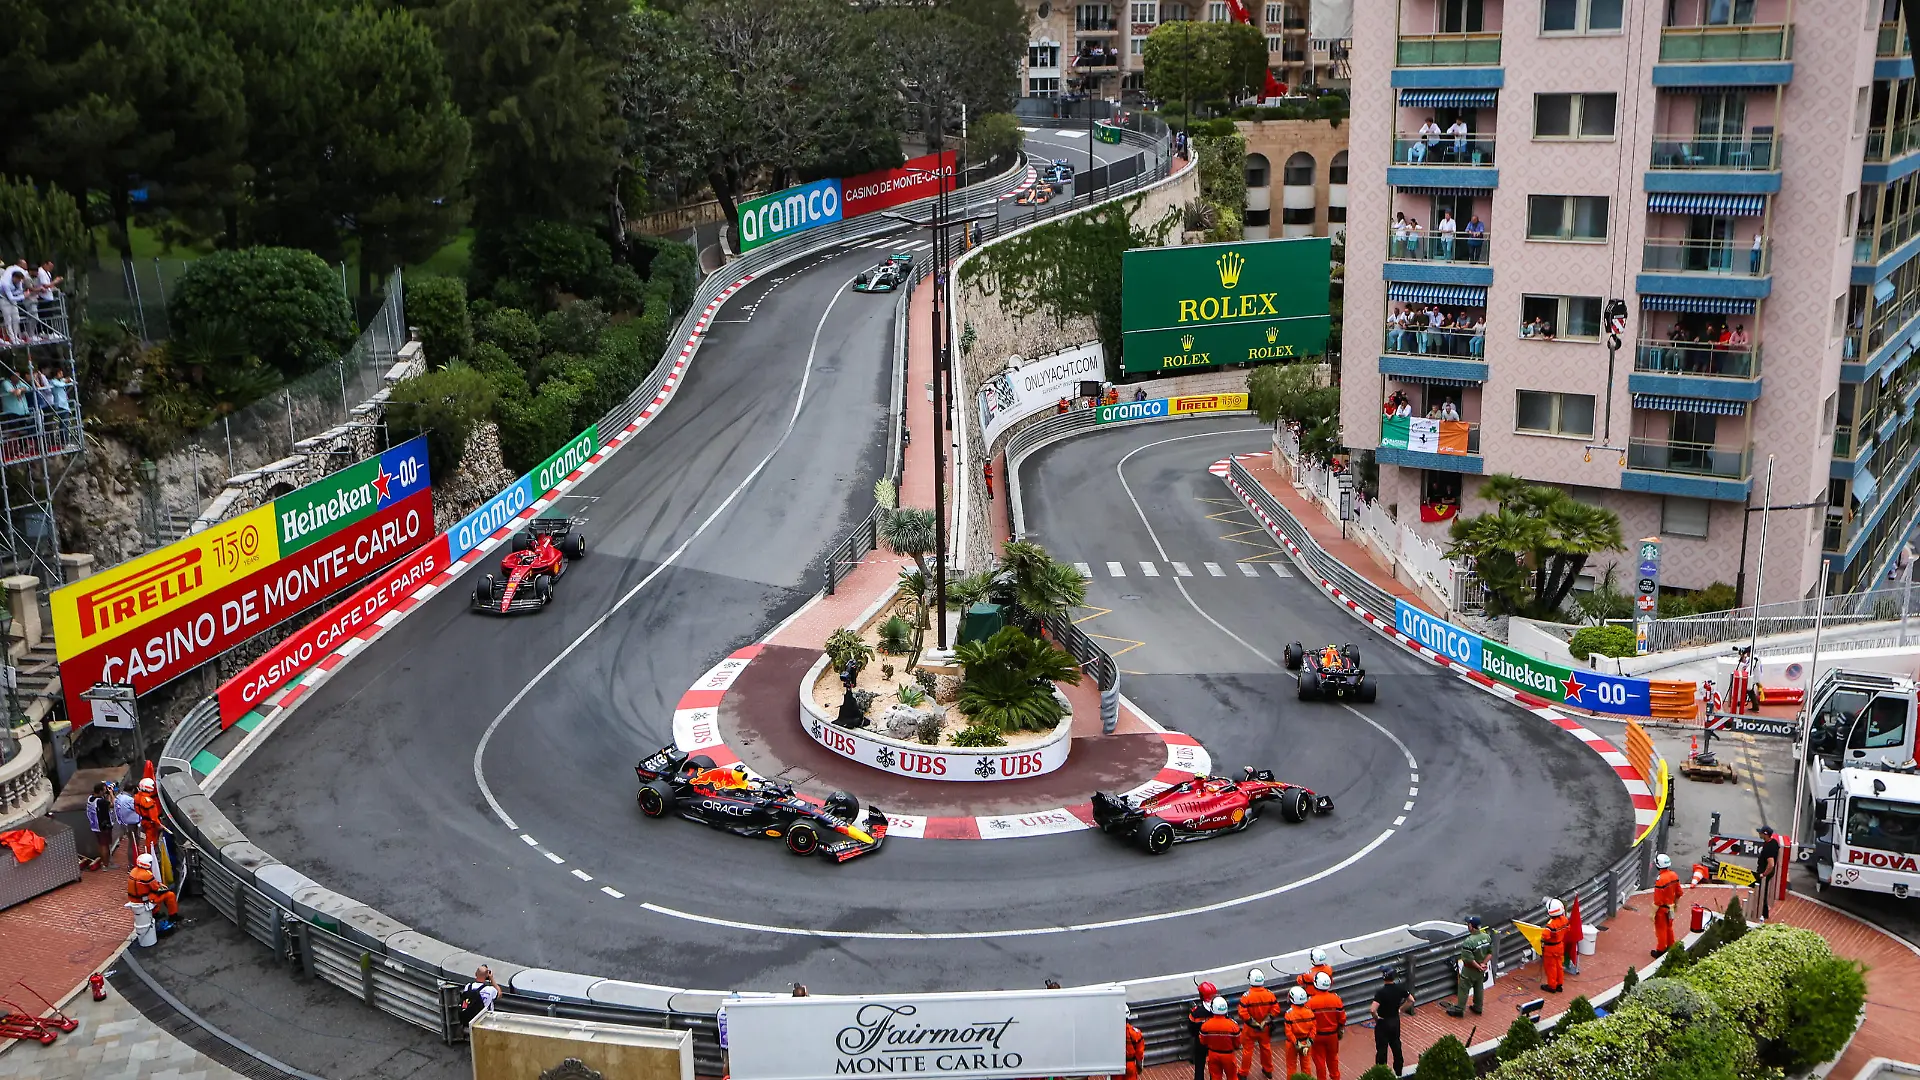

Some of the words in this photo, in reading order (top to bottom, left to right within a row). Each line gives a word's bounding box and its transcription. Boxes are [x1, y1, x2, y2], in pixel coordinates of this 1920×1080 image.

[846, 184, 879, 201] CASINO
[880, 180, 892, 194] DE
[743, 186, 838, 241] aramco
[1178, 292, 1279, 322] ROLEX
[1163, 352, 1210, 368] ROLEX
[1248, 344, 1294, 359] ROLEX
[1024, 355, 1098, 392] ONLYYACHT.COM
[1103, 401, 1161, 421] aramco
[1176, 396, 1218, 411] PIRELLI
[539, 436, 591, 490] aramco
[281, 481, 372, 545] Heineken
[459, 486, 525, 550] aramco
[243, 555, 260, 565] YEARS
[76, 547, 203, 638] PIRELLI
[212, 525, 259, 573] 150
[102, 612, 216, 686] CASINO
[221, 589, 260, 636] DE
[263, 509, 420, 615] MONTE-CARLO
[241, 642, 313, 703] CASINO
[316, 609, 364, 649] CAFE
[365, 590, 388, 616] DE
[390, 554, 434, 598] PARIS
[1402, 609, 1471, 663] aramco
[706, 670, 733, 688] UBS
[1482, 647, 1558, 694] Heineken
[692, 722, 713, 744] UBS
[1734, 717, 1792, 735] PIOVANO
[823, 726, 856, 756] UBS
[899, 751, 948, 776] UBS
[1000, 751, 1043, 777] UBS
[702, 799, 752, 817] ORACLE
[1018, 812, 1068, 827] UBS
[1150, 803, 1172, 814] Santander
[886, 816, 914, 828] BS
[1848, 848, 1918, 873] PIOVA
[835, 1003, 1020, 1056] Fairmont
[835, 1056, 926, 1075] MONTE
[936, 1052, 1023, 1071] CARLO
